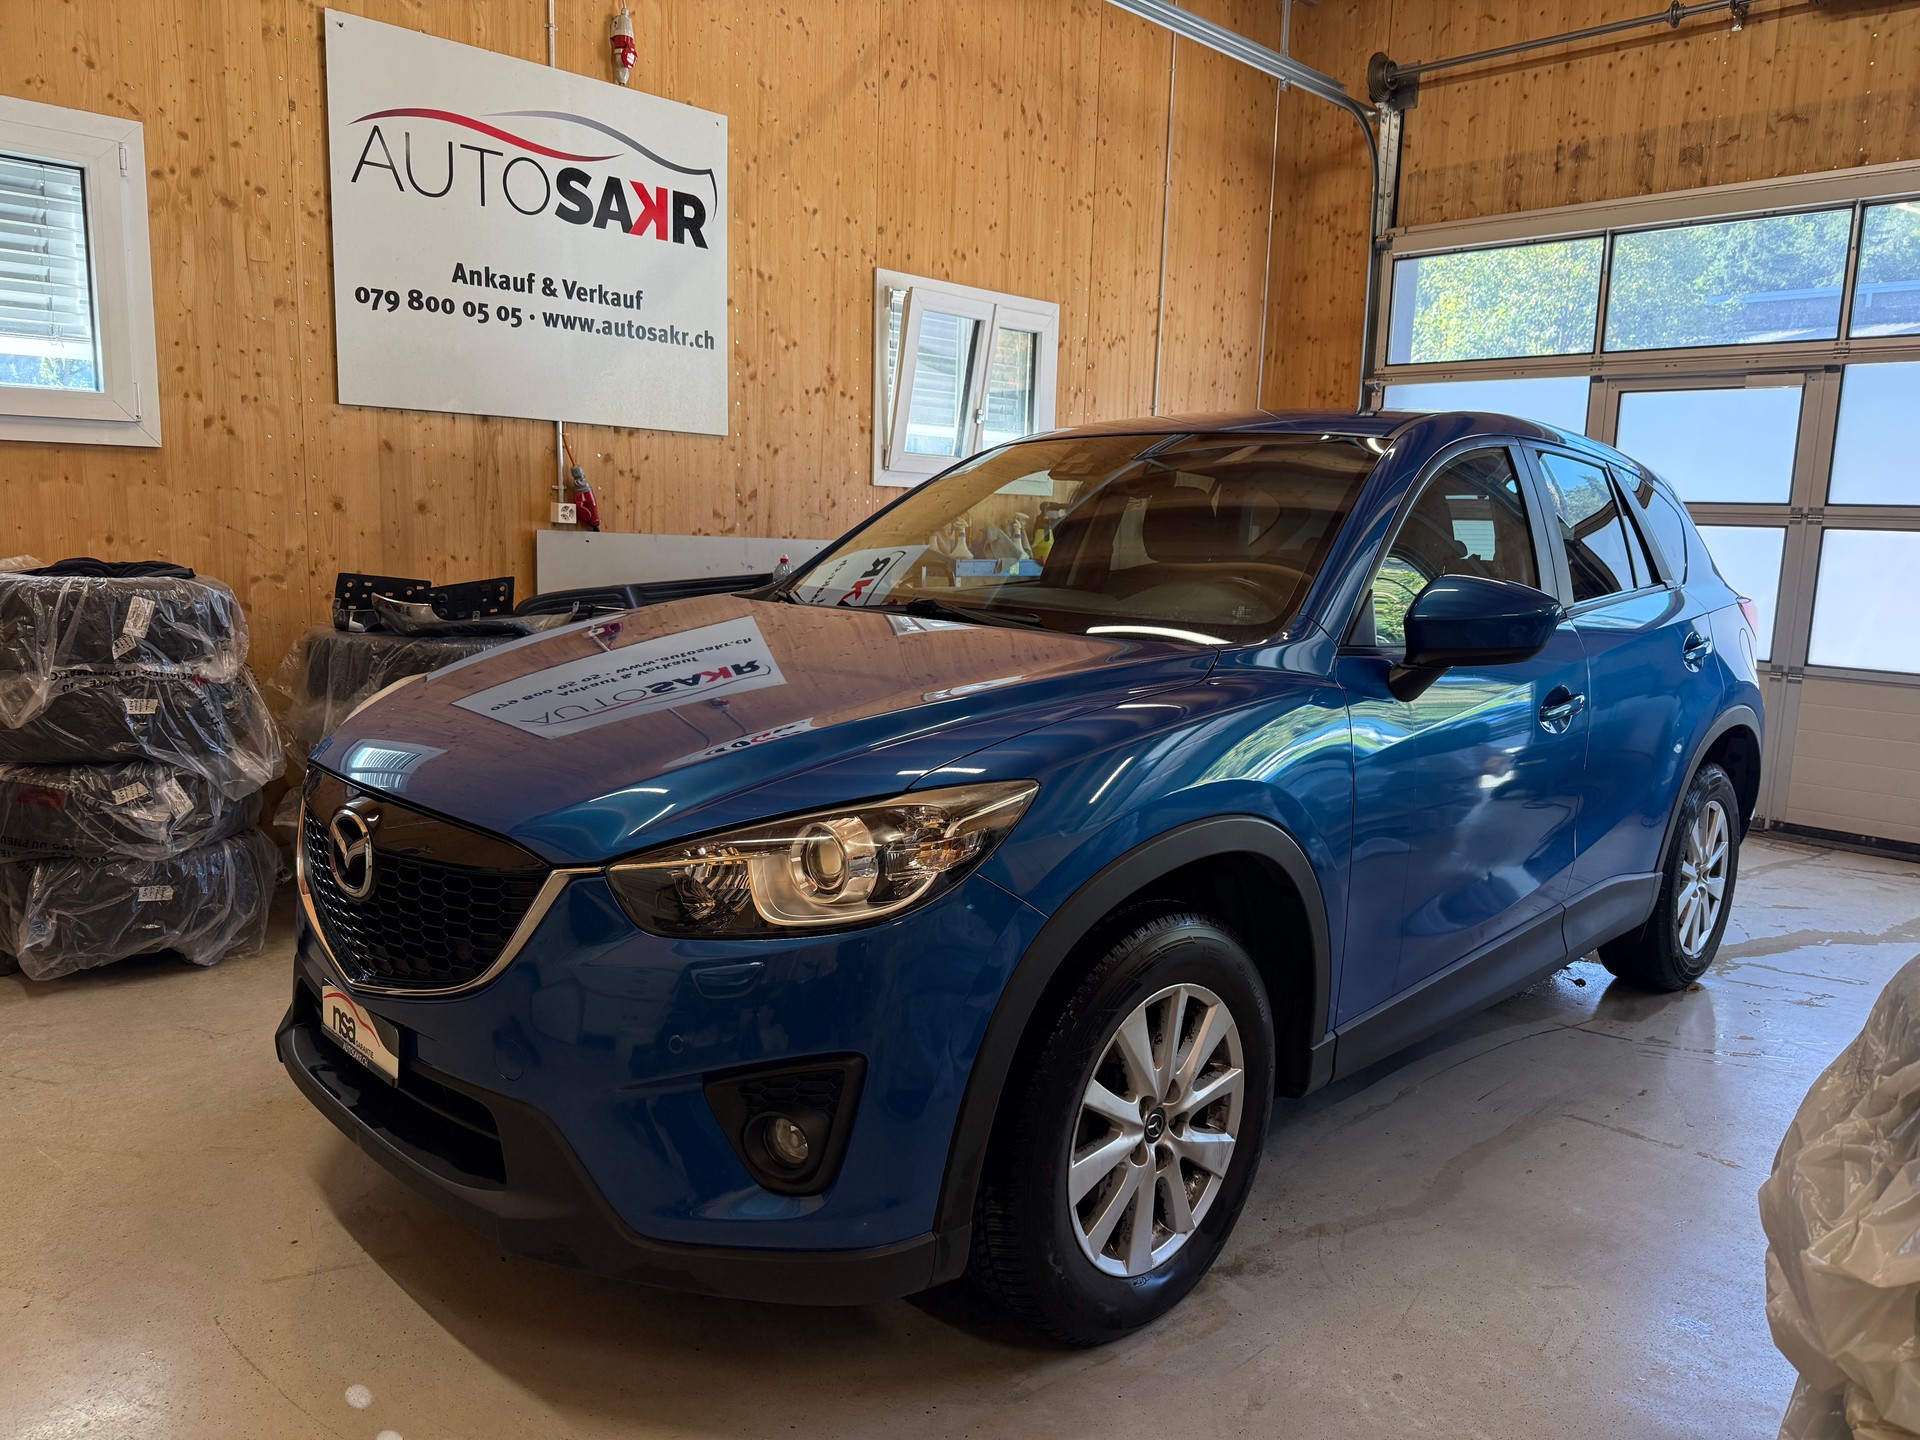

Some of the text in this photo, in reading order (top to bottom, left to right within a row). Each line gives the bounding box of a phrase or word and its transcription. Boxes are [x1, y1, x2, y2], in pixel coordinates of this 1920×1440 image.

[452, 262, 644, 311] Ankauf & Verkauf
[354, 286, 716, 351] 079 800 05 05 www.autosakr.ch
